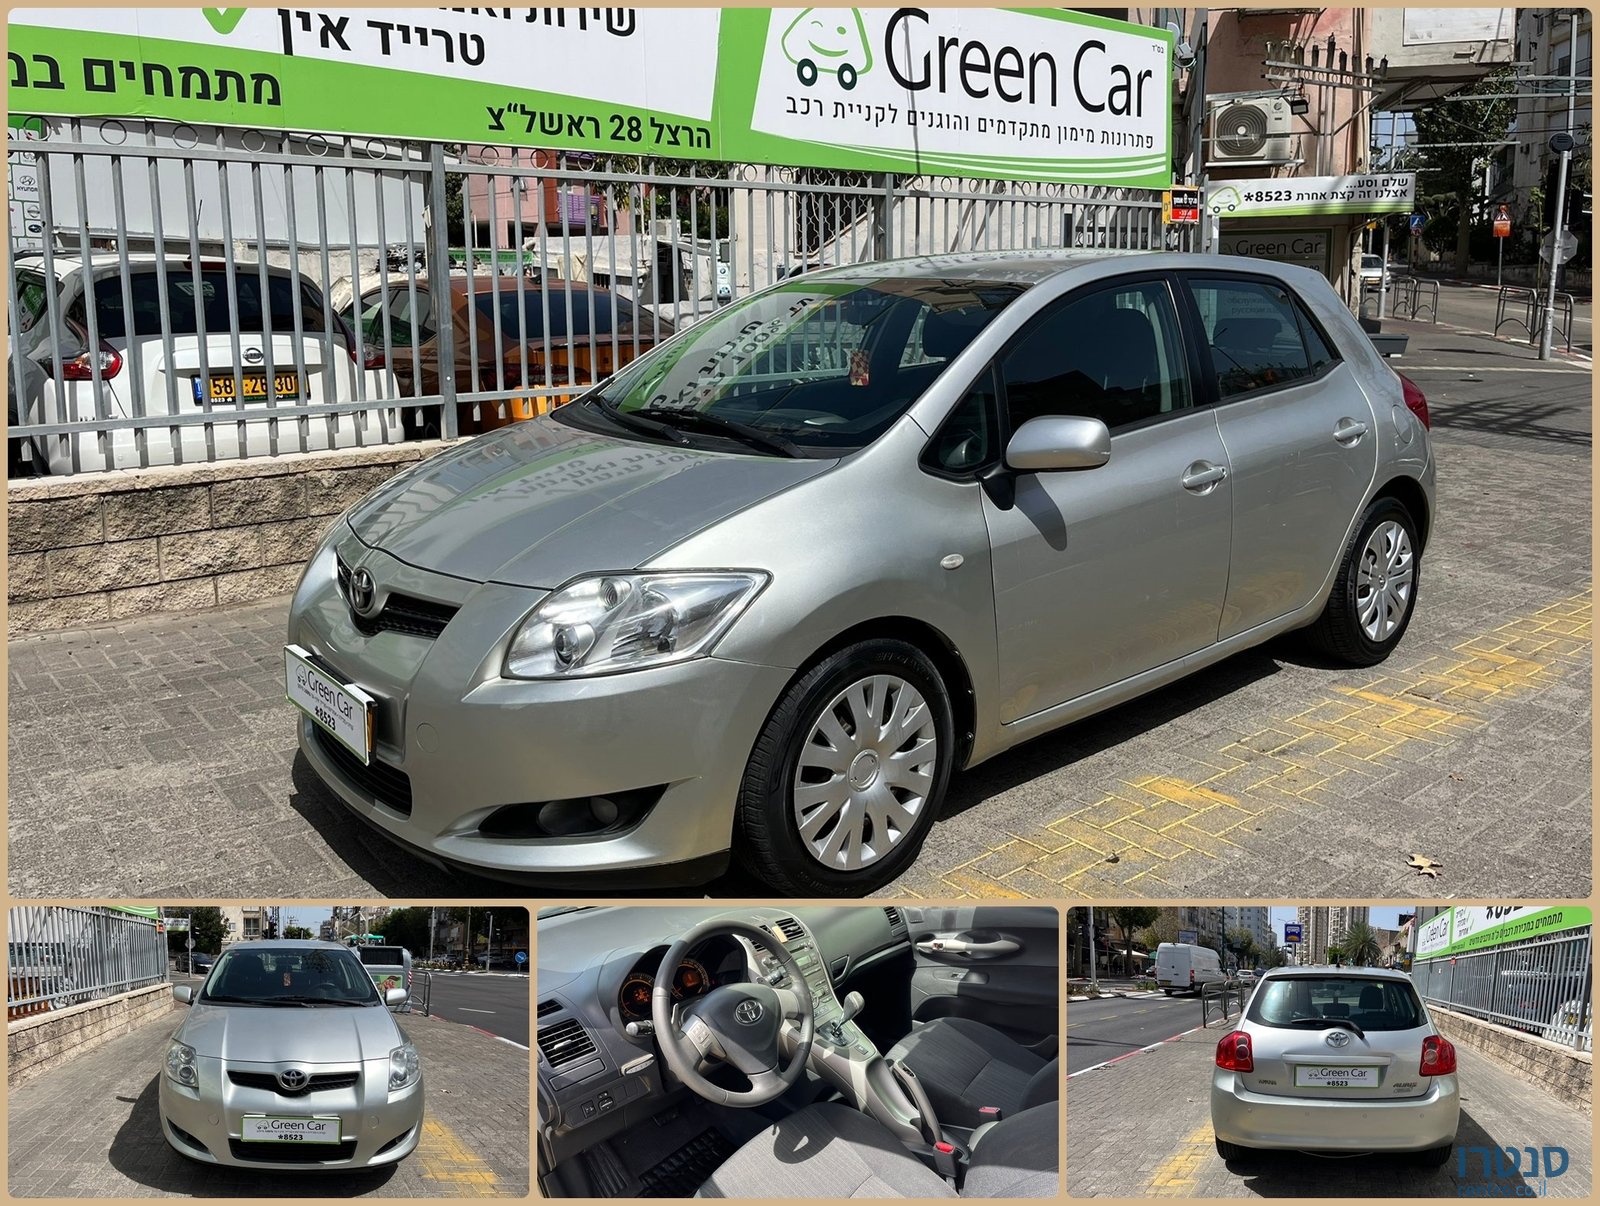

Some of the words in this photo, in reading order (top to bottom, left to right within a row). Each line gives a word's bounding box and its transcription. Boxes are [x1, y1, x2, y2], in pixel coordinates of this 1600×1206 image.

[277, 8, 351, 56] אין
[367, 20, 485, 66] טרייד
[884, 8, 1058, 107] Green
[1073, 39, 1152, 118] Car
[82, 57, 281, 106] מתמחים
[786, 95, 824, 117] רכב
[832, 100, 898, 128] לקניית
[609, 114, 642, 142] 28
[906, 109, 969, 132] והוגנים
[978, 118, 1051, 141] מתקדמים
[650, 116, 711, 149] הרצל
[1057, 124, 1095, 145] מימון
[1101, 130, 1153, 150] פתרונות
[1375, 188, 1408, 198] אצלנו
[1381, 177, 1408, 187] שלם
[1296, 192, 1327, 201] אחרת
[1330, 191, 1355, 201] קצת
[1358, 190, 1371, 198] זה
[1235, 239, 1287, 256] Green
[1291, 238, 1321, 254] Car
[308, 670, 335, 706] Green
[337, 692, 353, 720] Car
[1320, 1068, 1349, 1078] Green
[1351, 1068, 1367, 1077] Car
[271, 1119, 304, 1130] Green
[306, 1120, 326, 1131] Car
